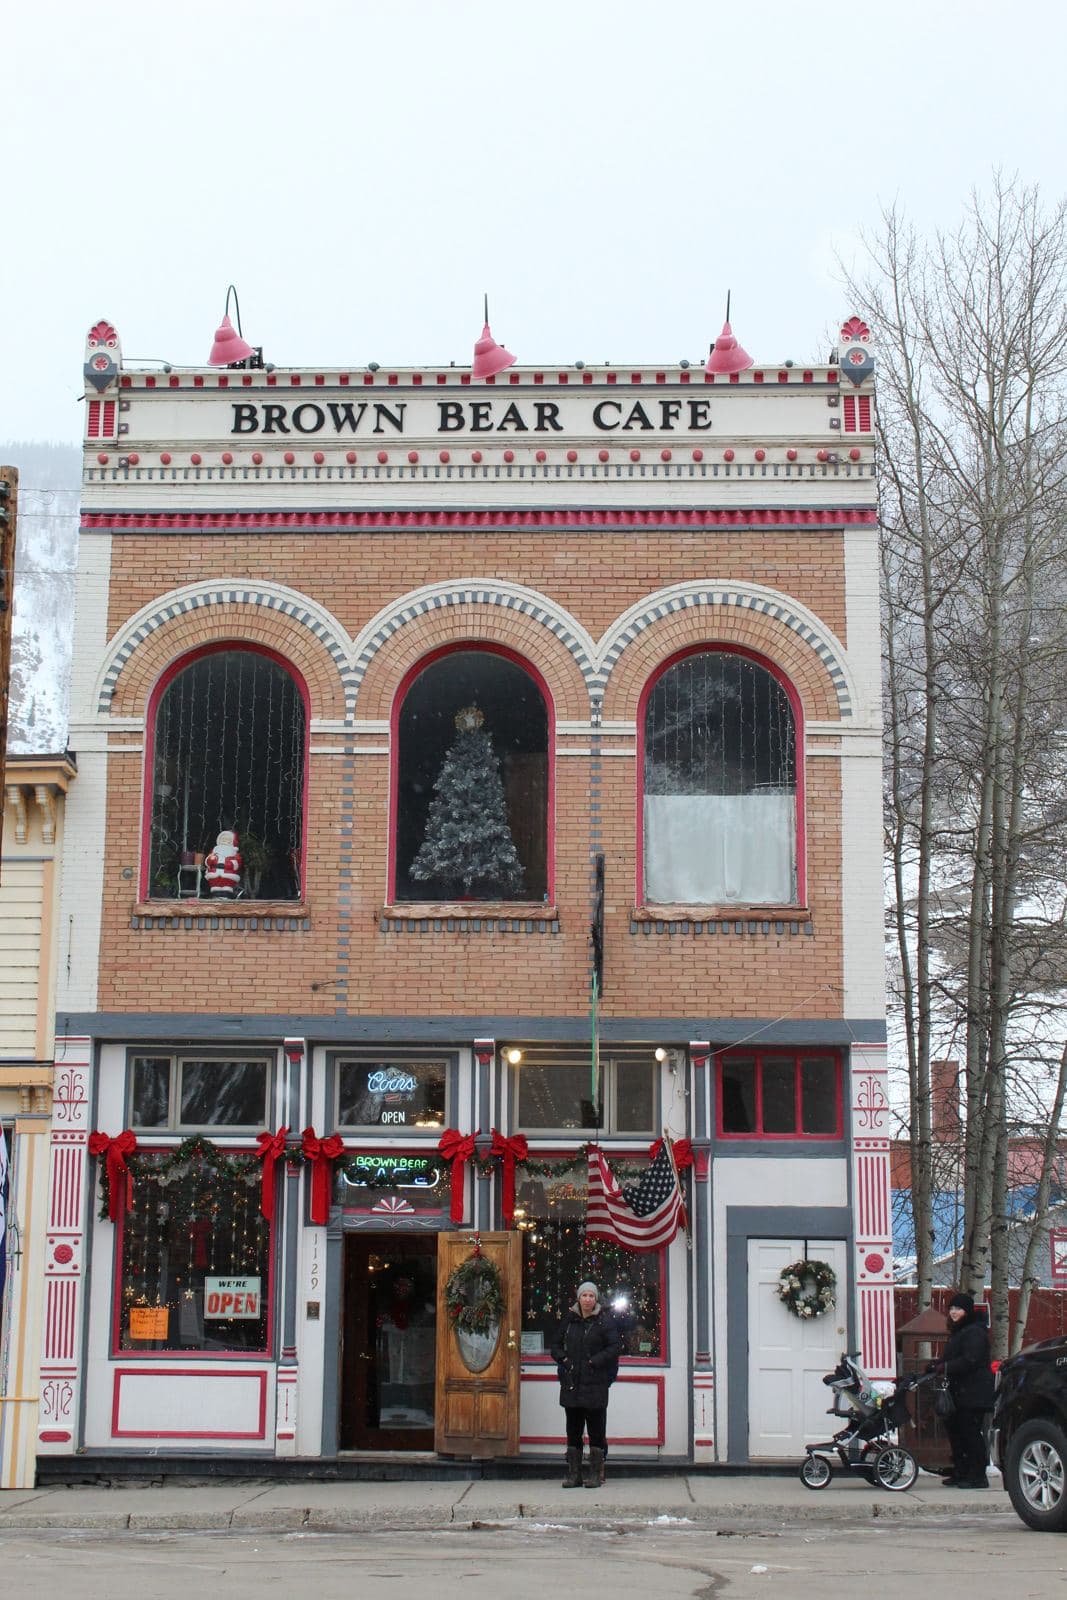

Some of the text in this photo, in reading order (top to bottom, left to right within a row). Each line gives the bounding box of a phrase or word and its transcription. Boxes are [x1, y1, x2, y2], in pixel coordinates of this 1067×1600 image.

[231, 400, 712, 433] BROWN BEAR CAFE
[367, 1071, 416, 1091] Coors
[381, 1111, 406, 1124] OPEN
[356, 1156, 397, 1168] BROWN
[218, 1280, 248, 1288] WE'RE
[208, 1292, 257, 1313] OPEN
